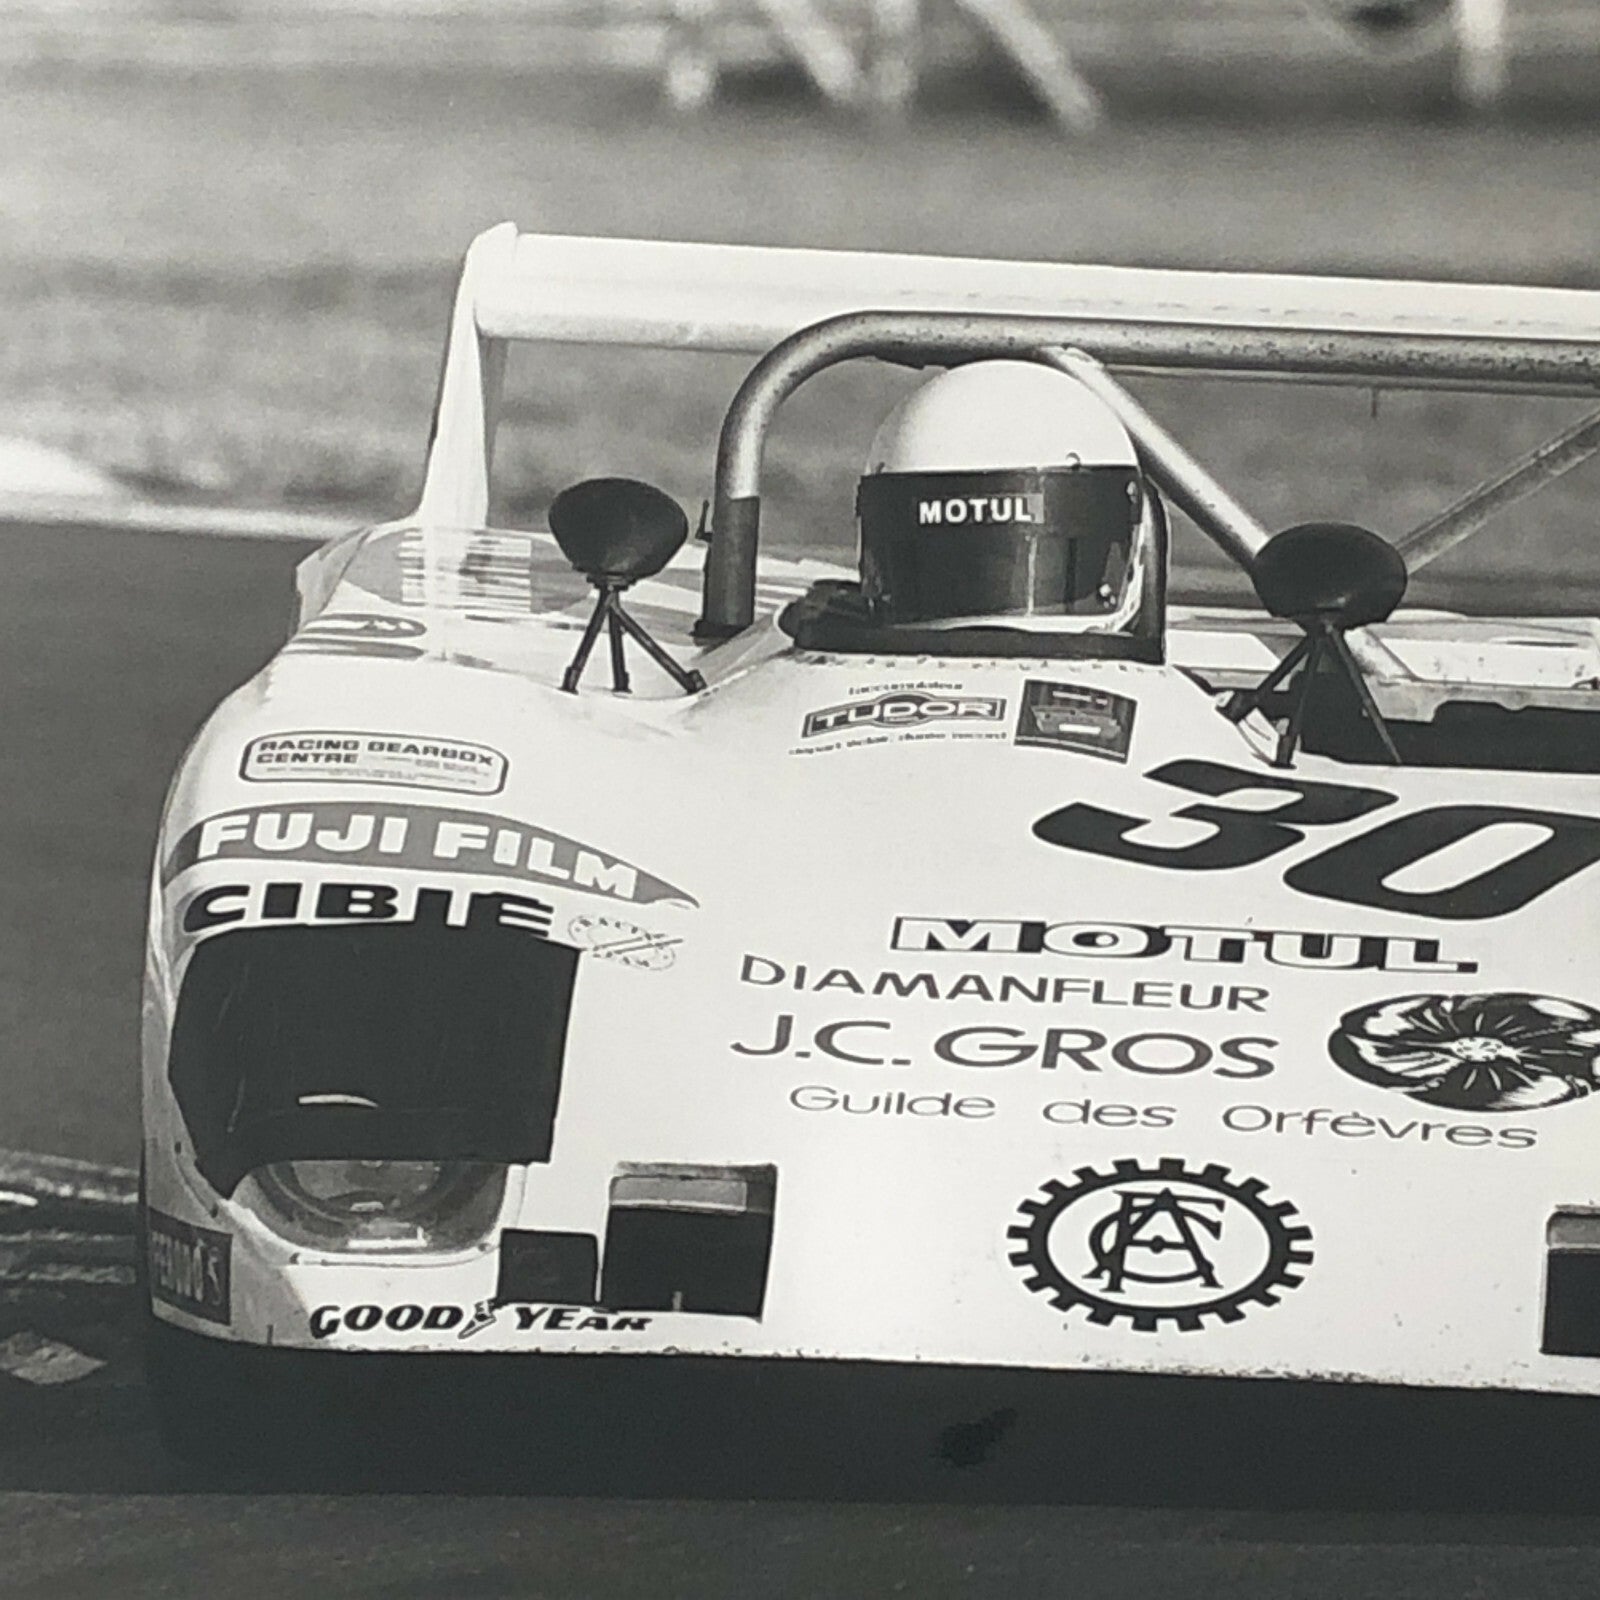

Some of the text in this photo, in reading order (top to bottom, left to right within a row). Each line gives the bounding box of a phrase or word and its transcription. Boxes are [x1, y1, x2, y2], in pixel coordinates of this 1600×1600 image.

[918, 497, 1032, 525] MOTUL
[816, 701, 994, 728] TUDOR
[256, 753, 360, 764] CENTRE
[259, 739, 495, 766] RACING GEARBOX
[198, 812, 639, 900] FUJI FILM
[1031, 759, 1600, 920] 30
[890, 916, 1479, 974] MOTUL
[739, 954, 1272, 1013] DIAMANFLEUR
[934, 1023, 1278, 1079] GROS
[789, 1084, 1540, 1151] Guilde des Orfèvres
[310, 1304, 653, 1338] GOOD YEAR
